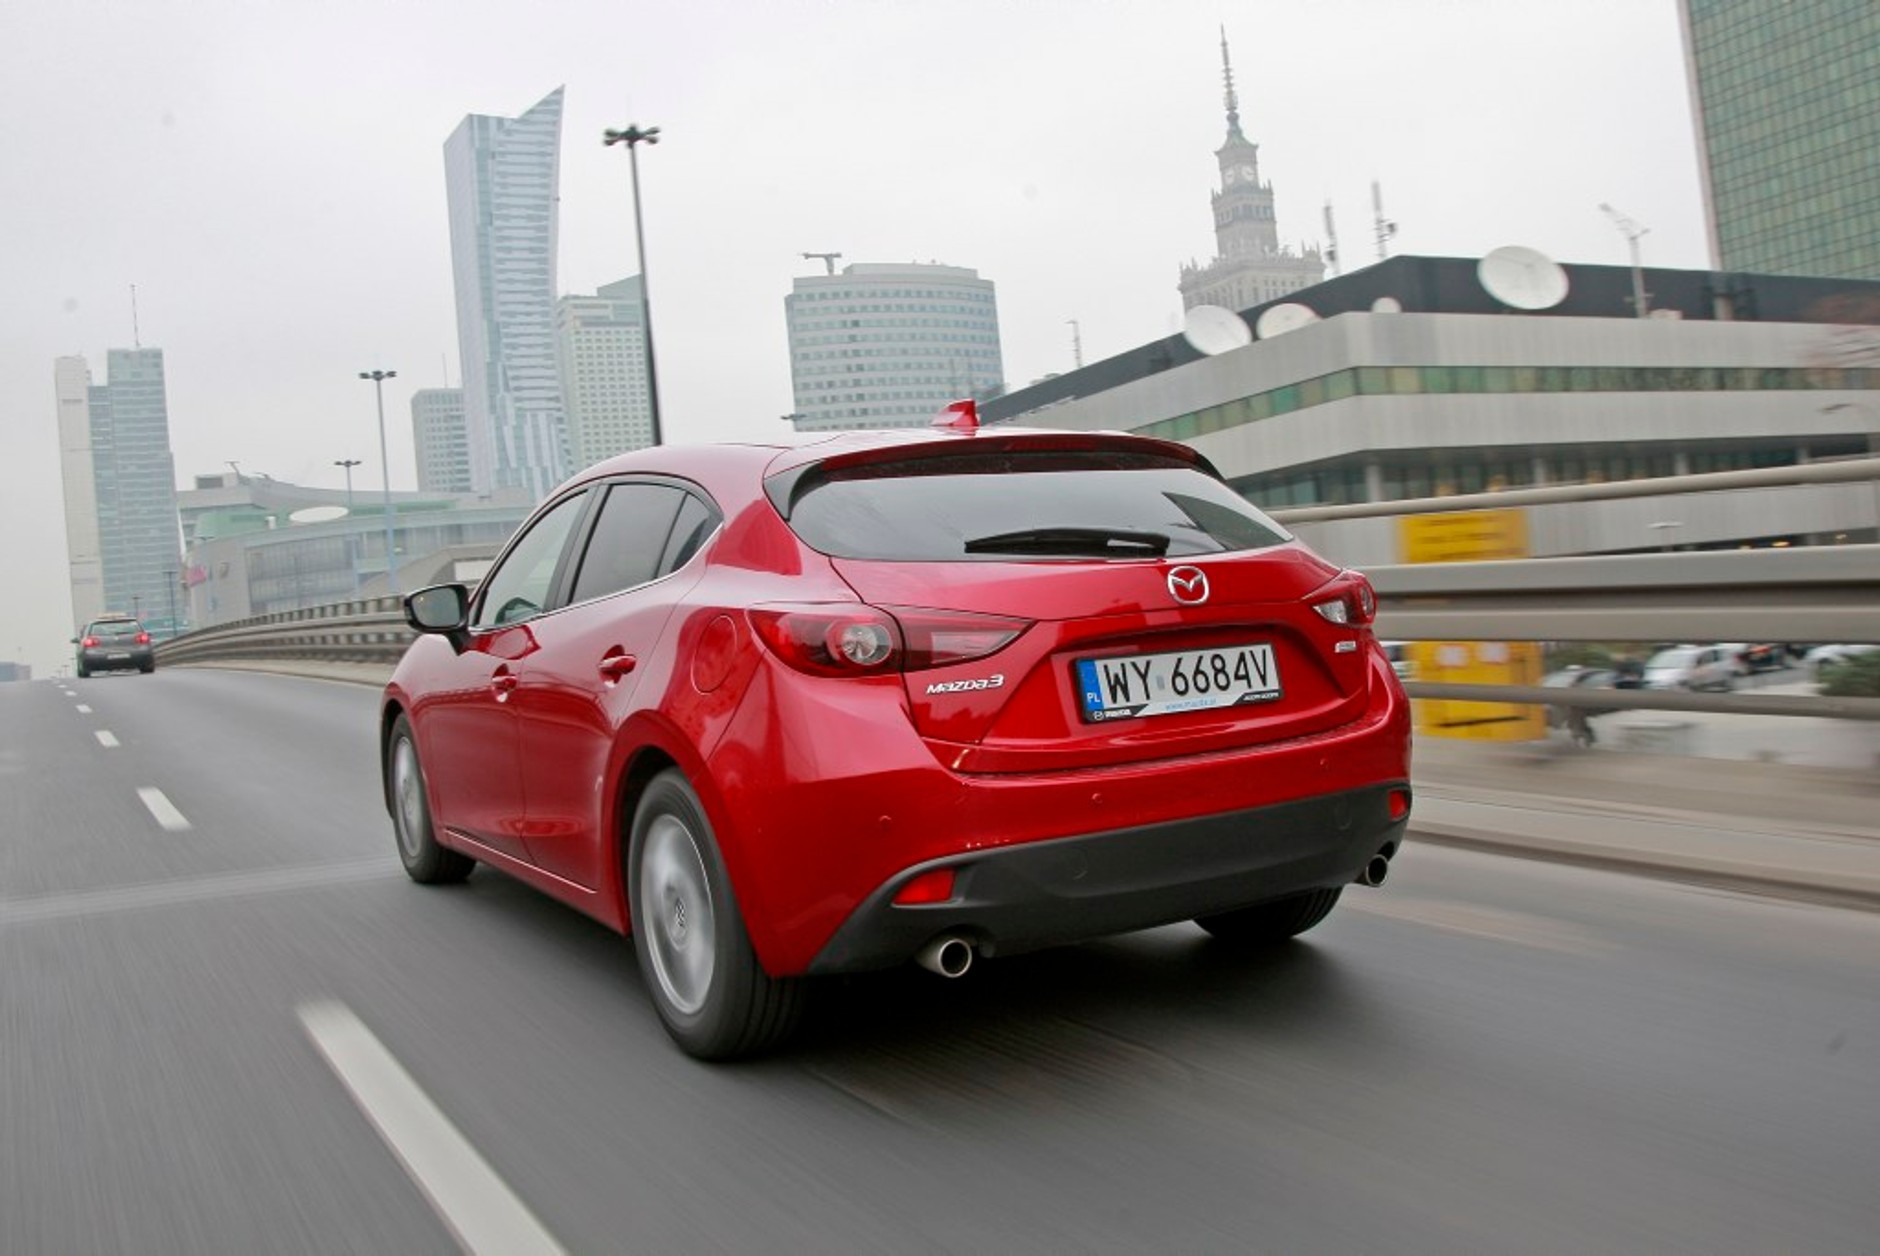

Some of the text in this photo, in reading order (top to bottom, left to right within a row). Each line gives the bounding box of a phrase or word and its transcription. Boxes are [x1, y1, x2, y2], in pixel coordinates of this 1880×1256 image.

[1103, 649, 1267, 705] WY 6684V
[1087, 692, 1101, 704] PL
